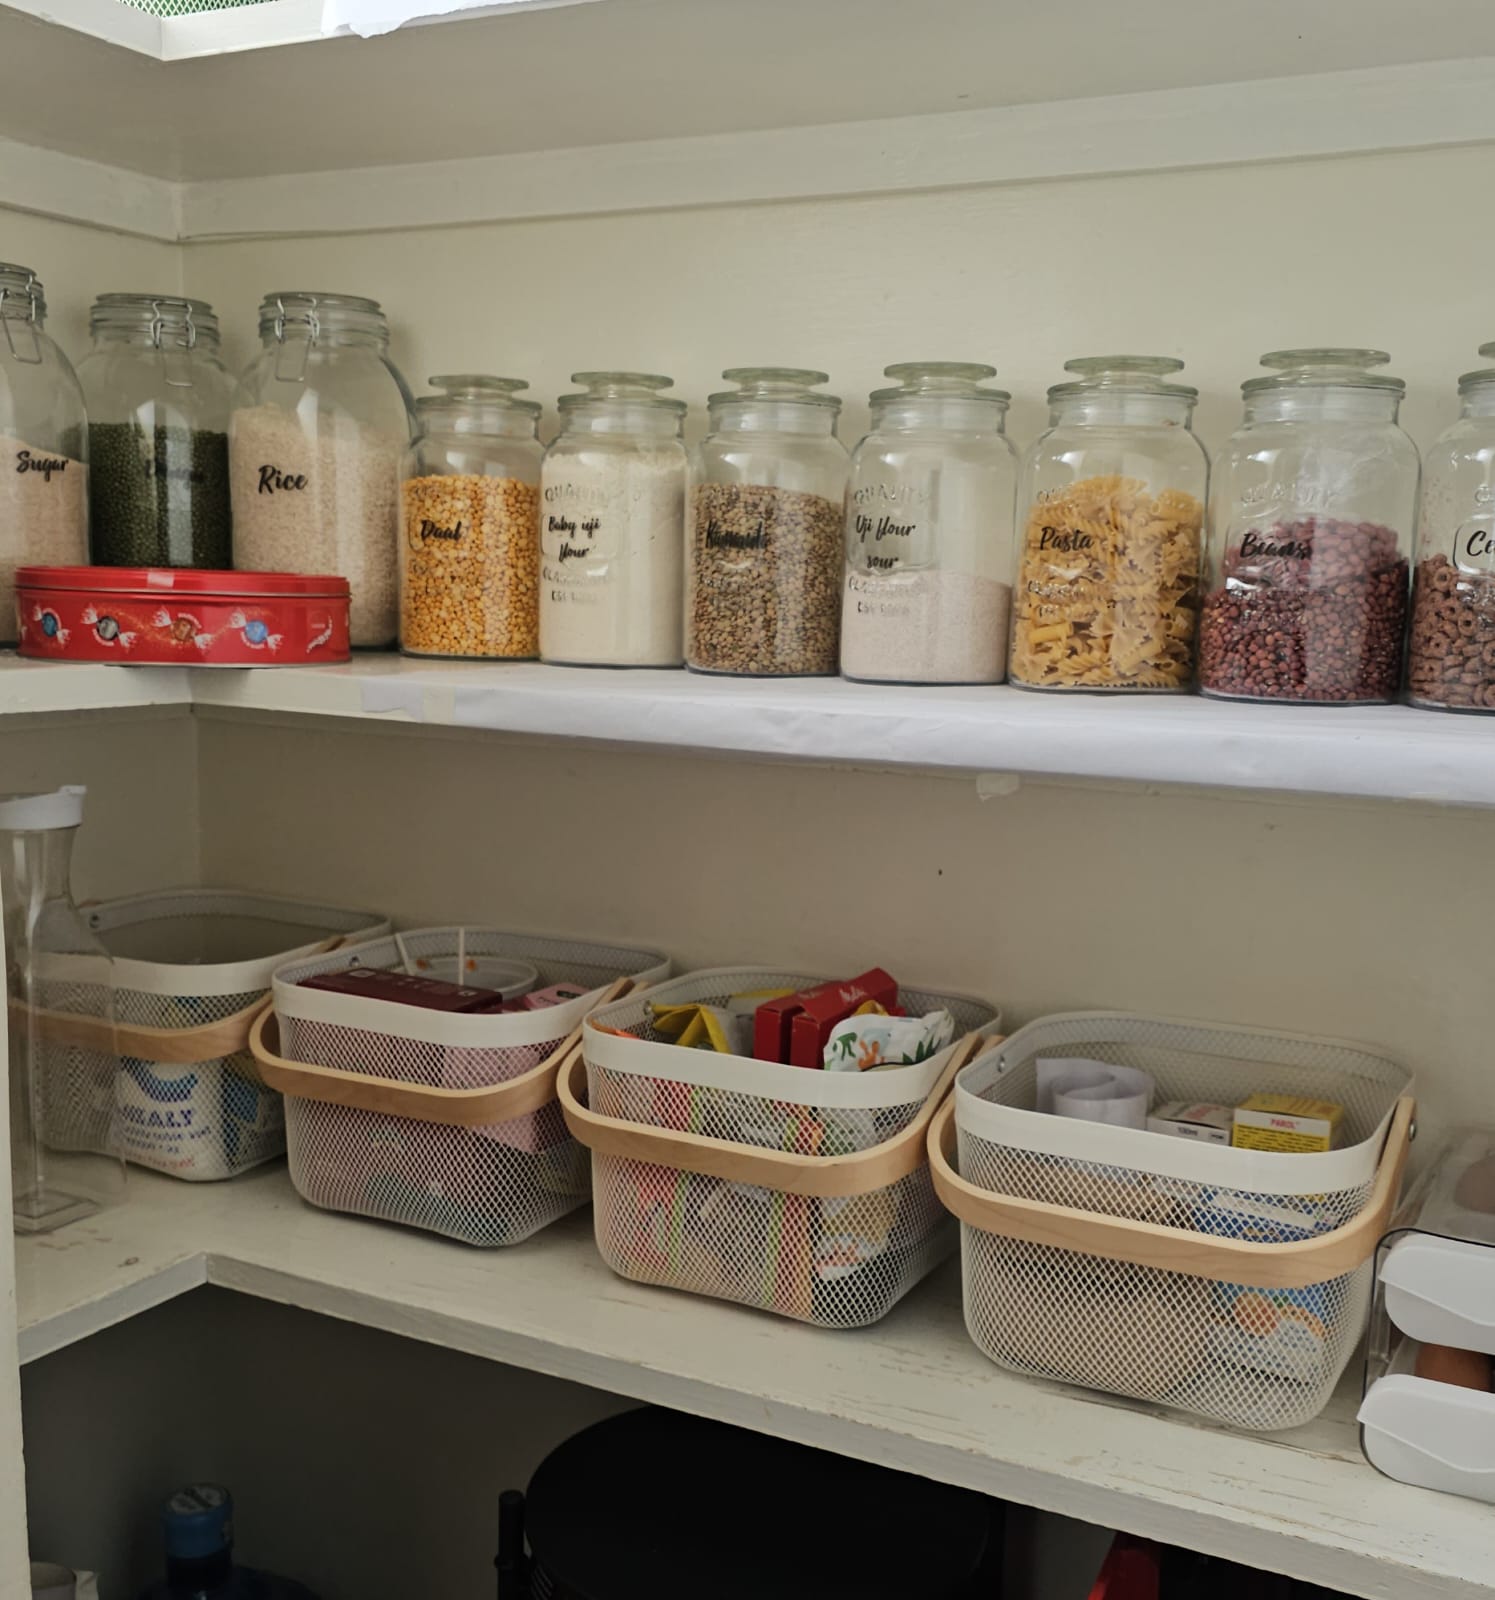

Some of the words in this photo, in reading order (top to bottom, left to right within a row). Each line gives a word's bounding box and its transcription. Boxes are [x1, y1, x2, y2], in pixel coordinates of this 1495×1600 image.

[16, 451, 70, 484] Sugar
[258, 464, 308, 494] Rice
[420, 519, 462, 541] Daal
[548, 515, 577, 538] Baby
[581, 516, 602, 538] uji
[856, 514, 873, 543] Uji
[875, 516, 916, 541] flour
[1039, 526, 1094, 552] Pasta
[558, 542, 590, 563] flour
[1239, 533, 1312, 559] Beans
[866, 555, 899, 569] sour
